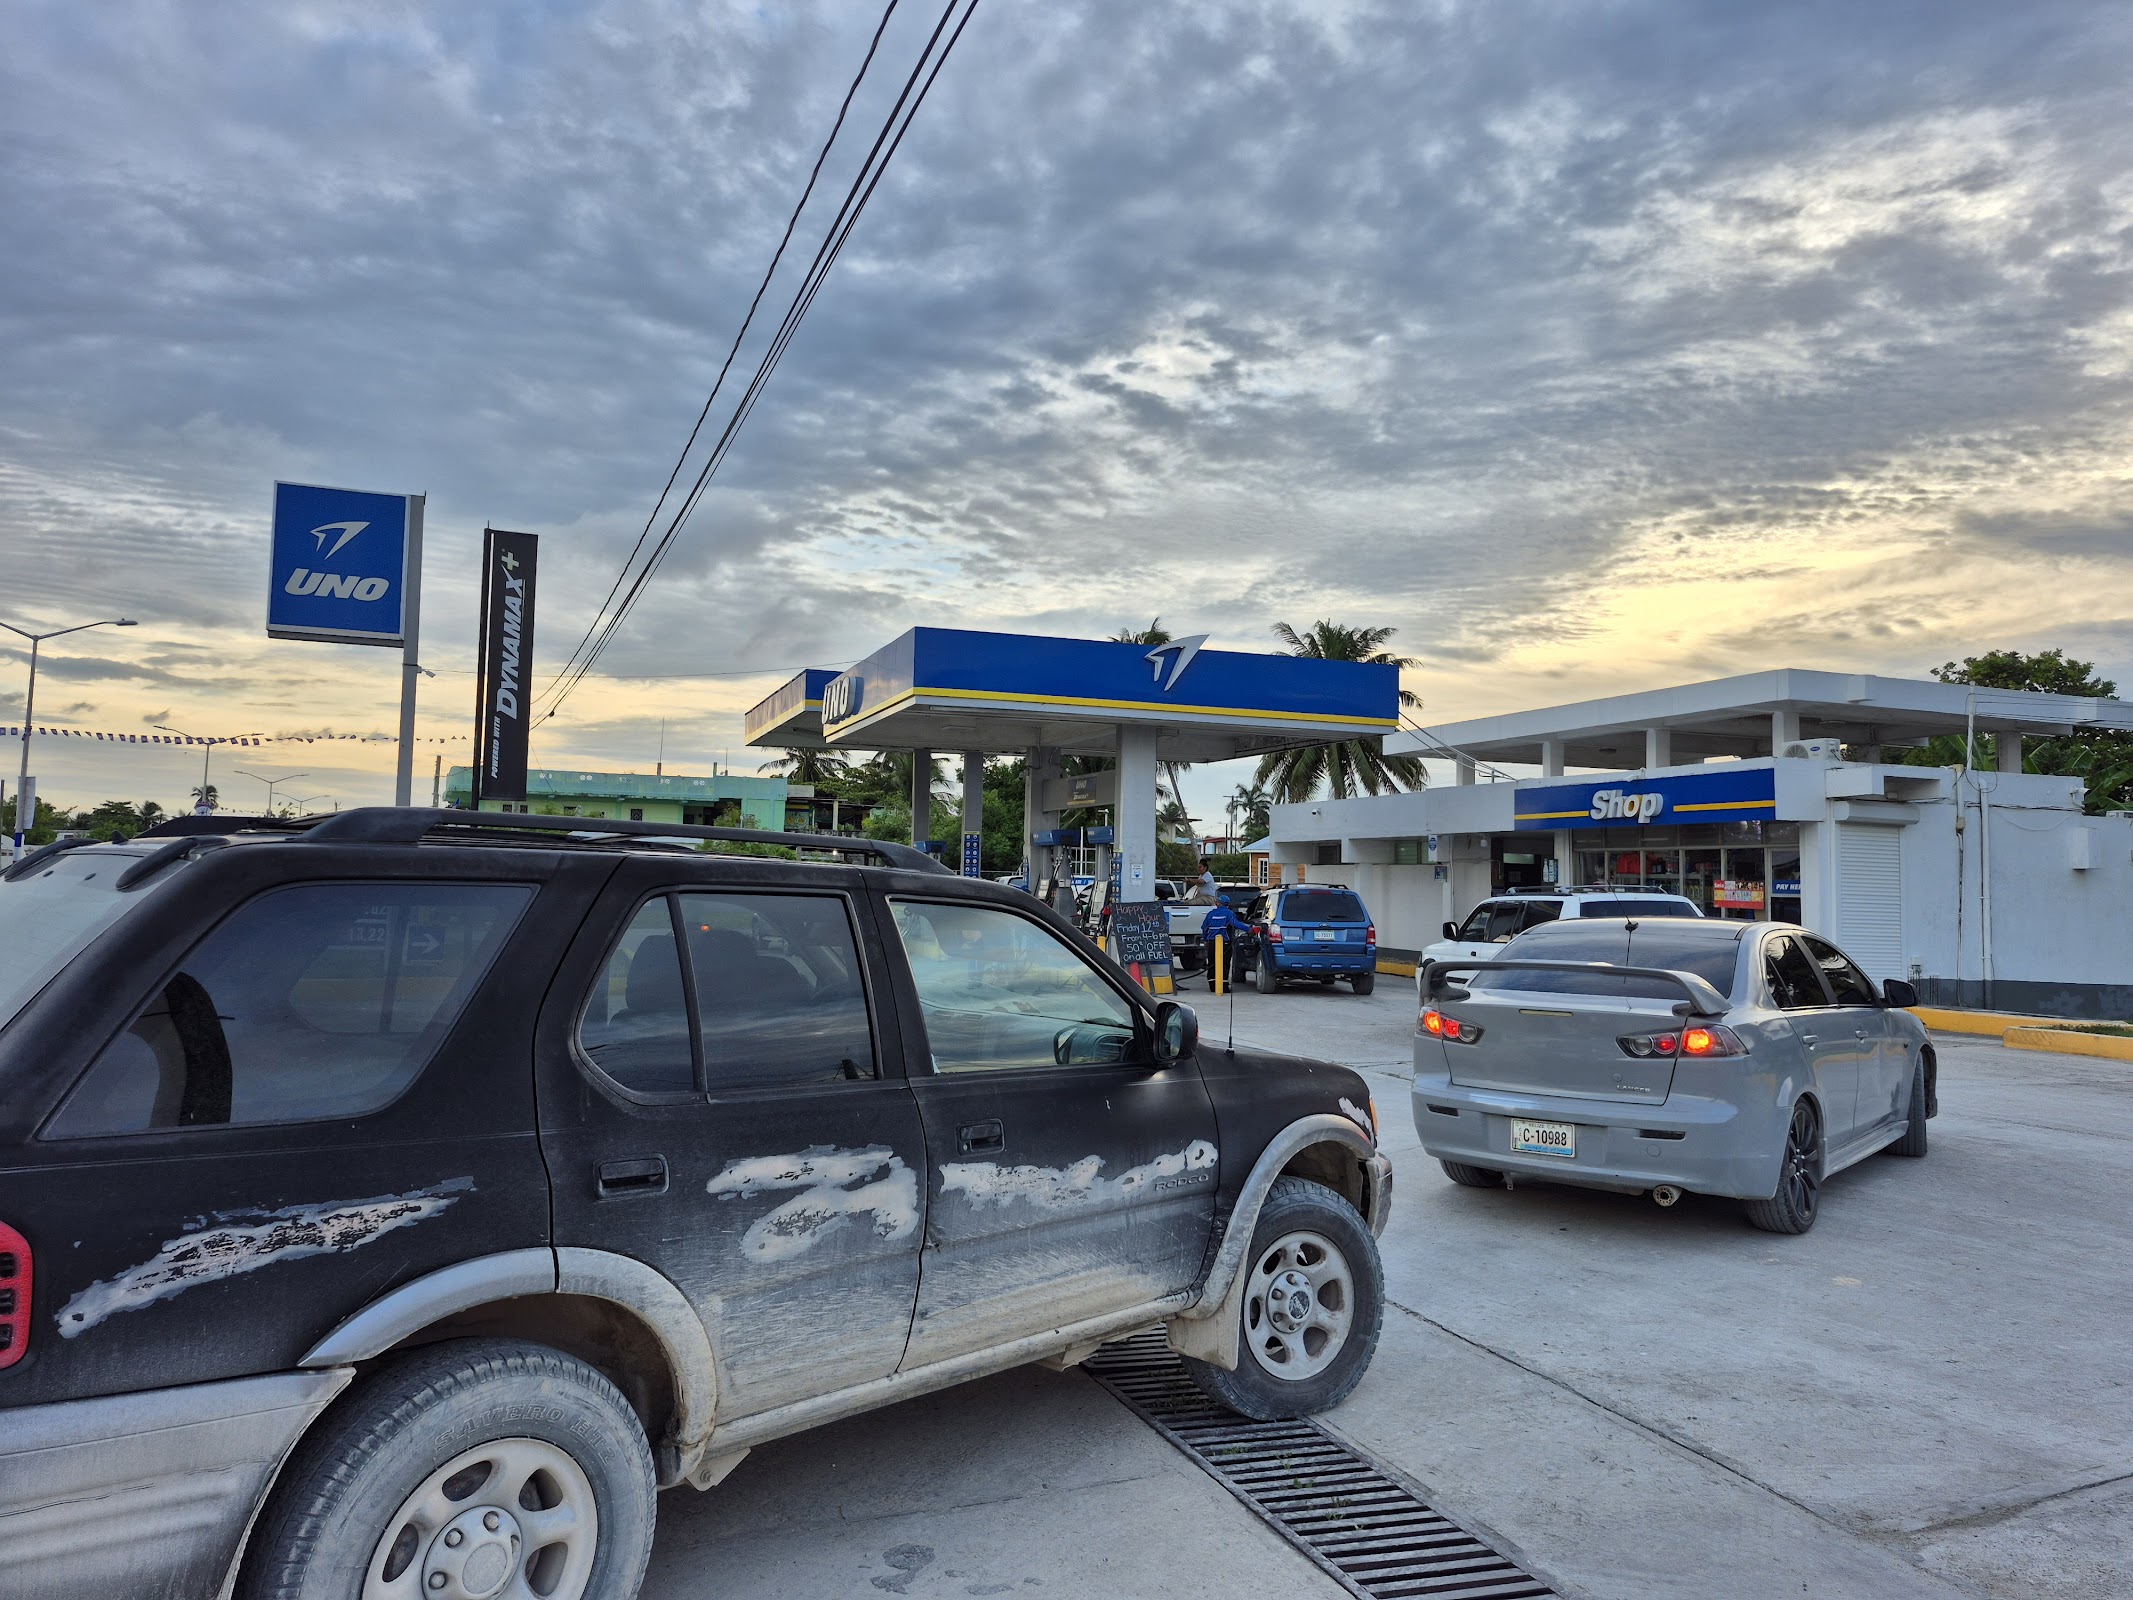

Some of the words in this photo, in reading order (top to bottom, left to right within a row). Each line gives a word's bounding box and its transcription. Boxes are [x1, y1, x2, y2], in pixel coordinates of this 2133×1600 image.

[284, 567, 390, 601] UNO
[822, 676, 858, 725] UNO
[493, 716, 501, 739] WITH
[491, 741, 500, 779] POWERED
[1590, 789, 1664, 824] Shop
[1115, 905, 1144, 916] Happy
[1138, 914, 1160, 922] Hour
[1116, 923, 1140, 933] Friday
[1121, 934, 1142, 942] From
[1146, 941, 1165, 951] OFF
[1148, 951, 1168, 959] FUEL
[1523, 1128, 1567, 1146] C-10988
[1155, 1173, 1209, 1191] RODEO
[434, 1403, 565, 1454] SAVERO
